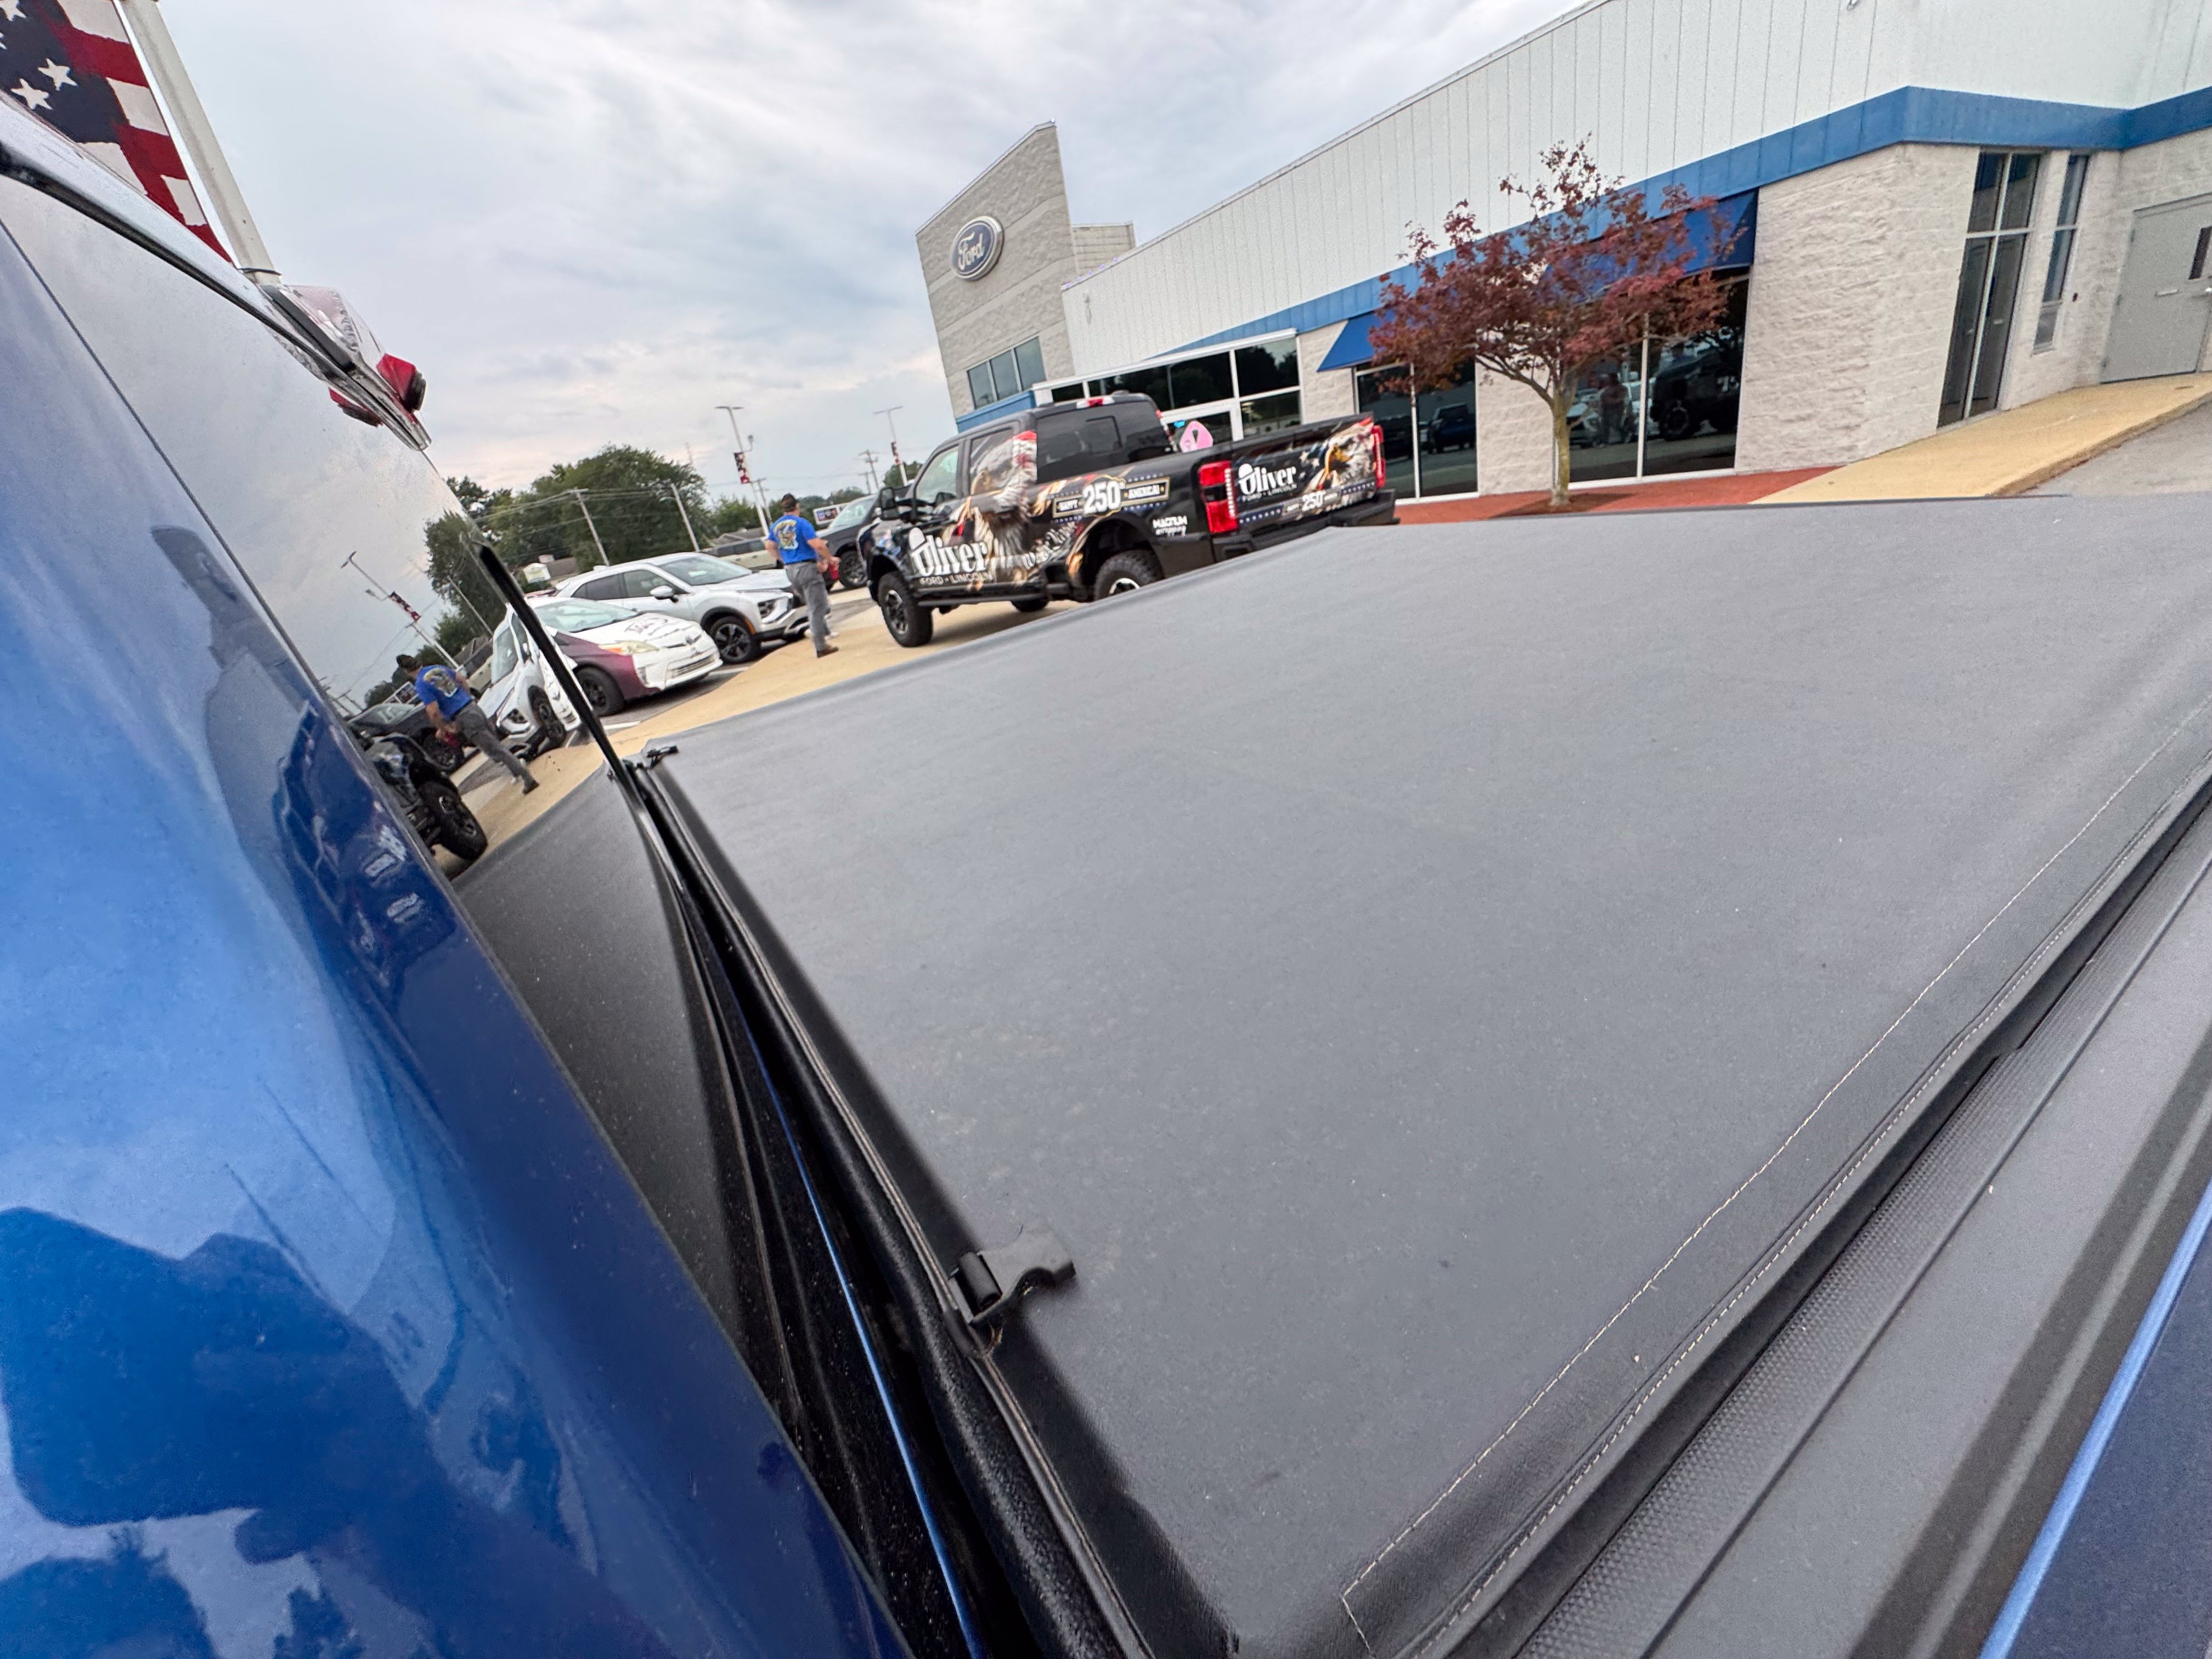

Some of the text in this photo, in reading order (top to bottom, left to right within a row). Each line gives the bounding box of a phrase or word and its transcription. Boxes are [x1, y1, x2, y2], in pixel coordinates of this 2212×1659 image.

[957, 232, 985, 270] Ford
[1238, 463, 1296, 494] Oliver
[909, 527, 988, 577] Oliver
[919, 571, 994, 585] FORD LINCOLN
